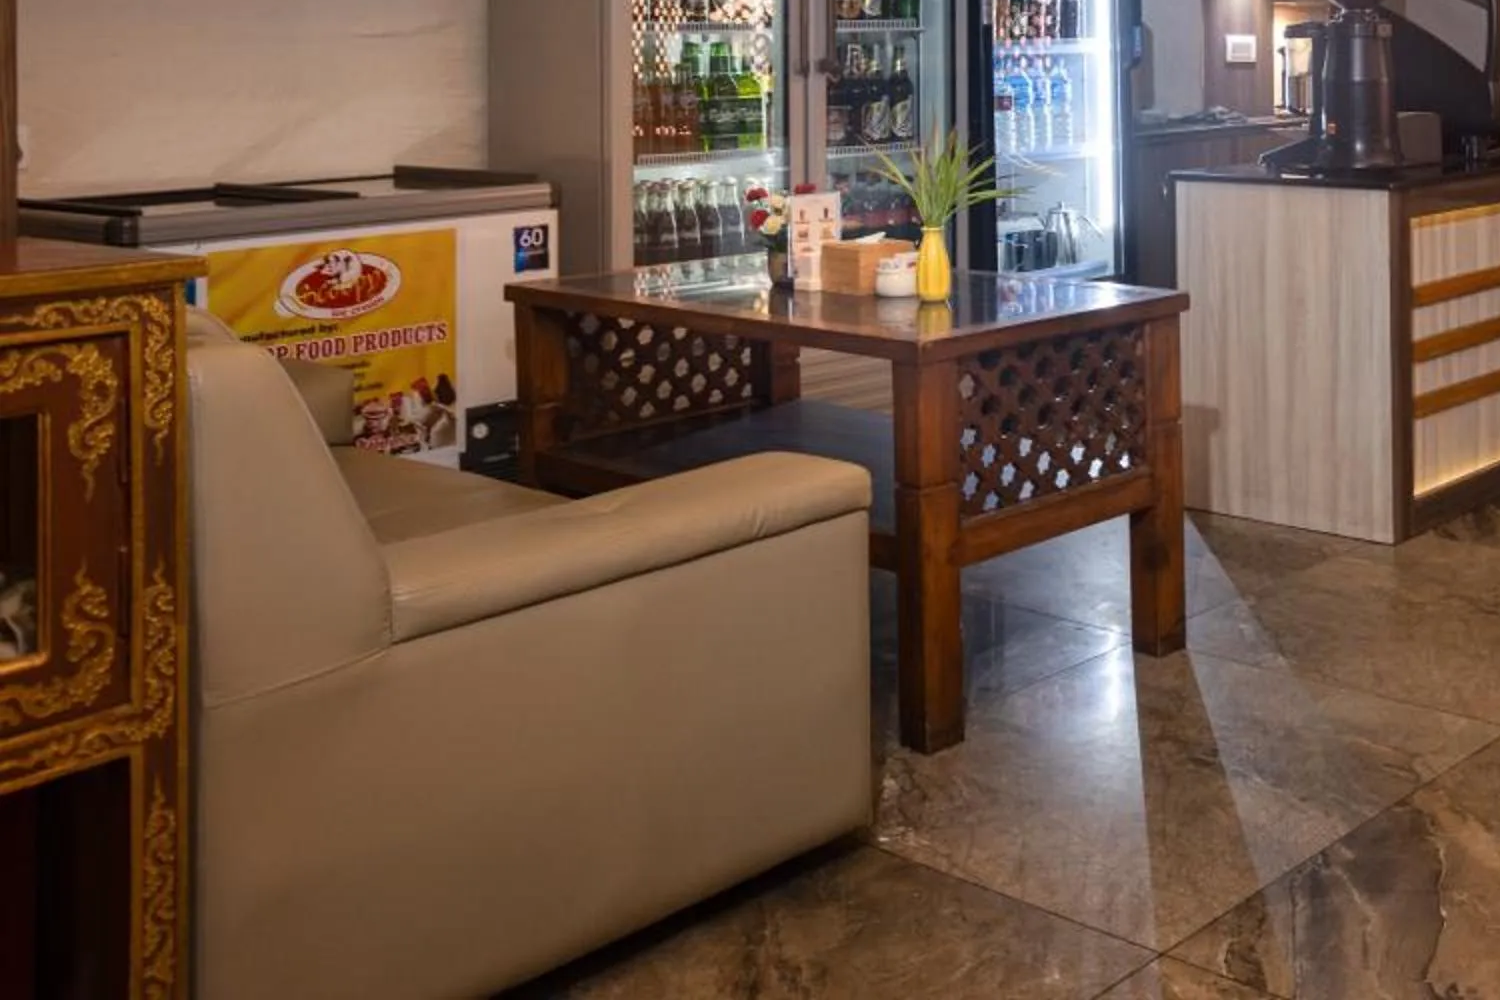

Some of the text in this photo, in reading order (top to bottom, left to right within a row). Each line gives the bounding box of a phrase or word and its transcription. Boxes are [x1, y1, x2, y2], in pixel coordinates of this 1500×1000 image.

[520, 228, 544, 247] 60
[296, 337, 346, 360] FOOD
[352, 323, 448, 354] PRODUCTS
